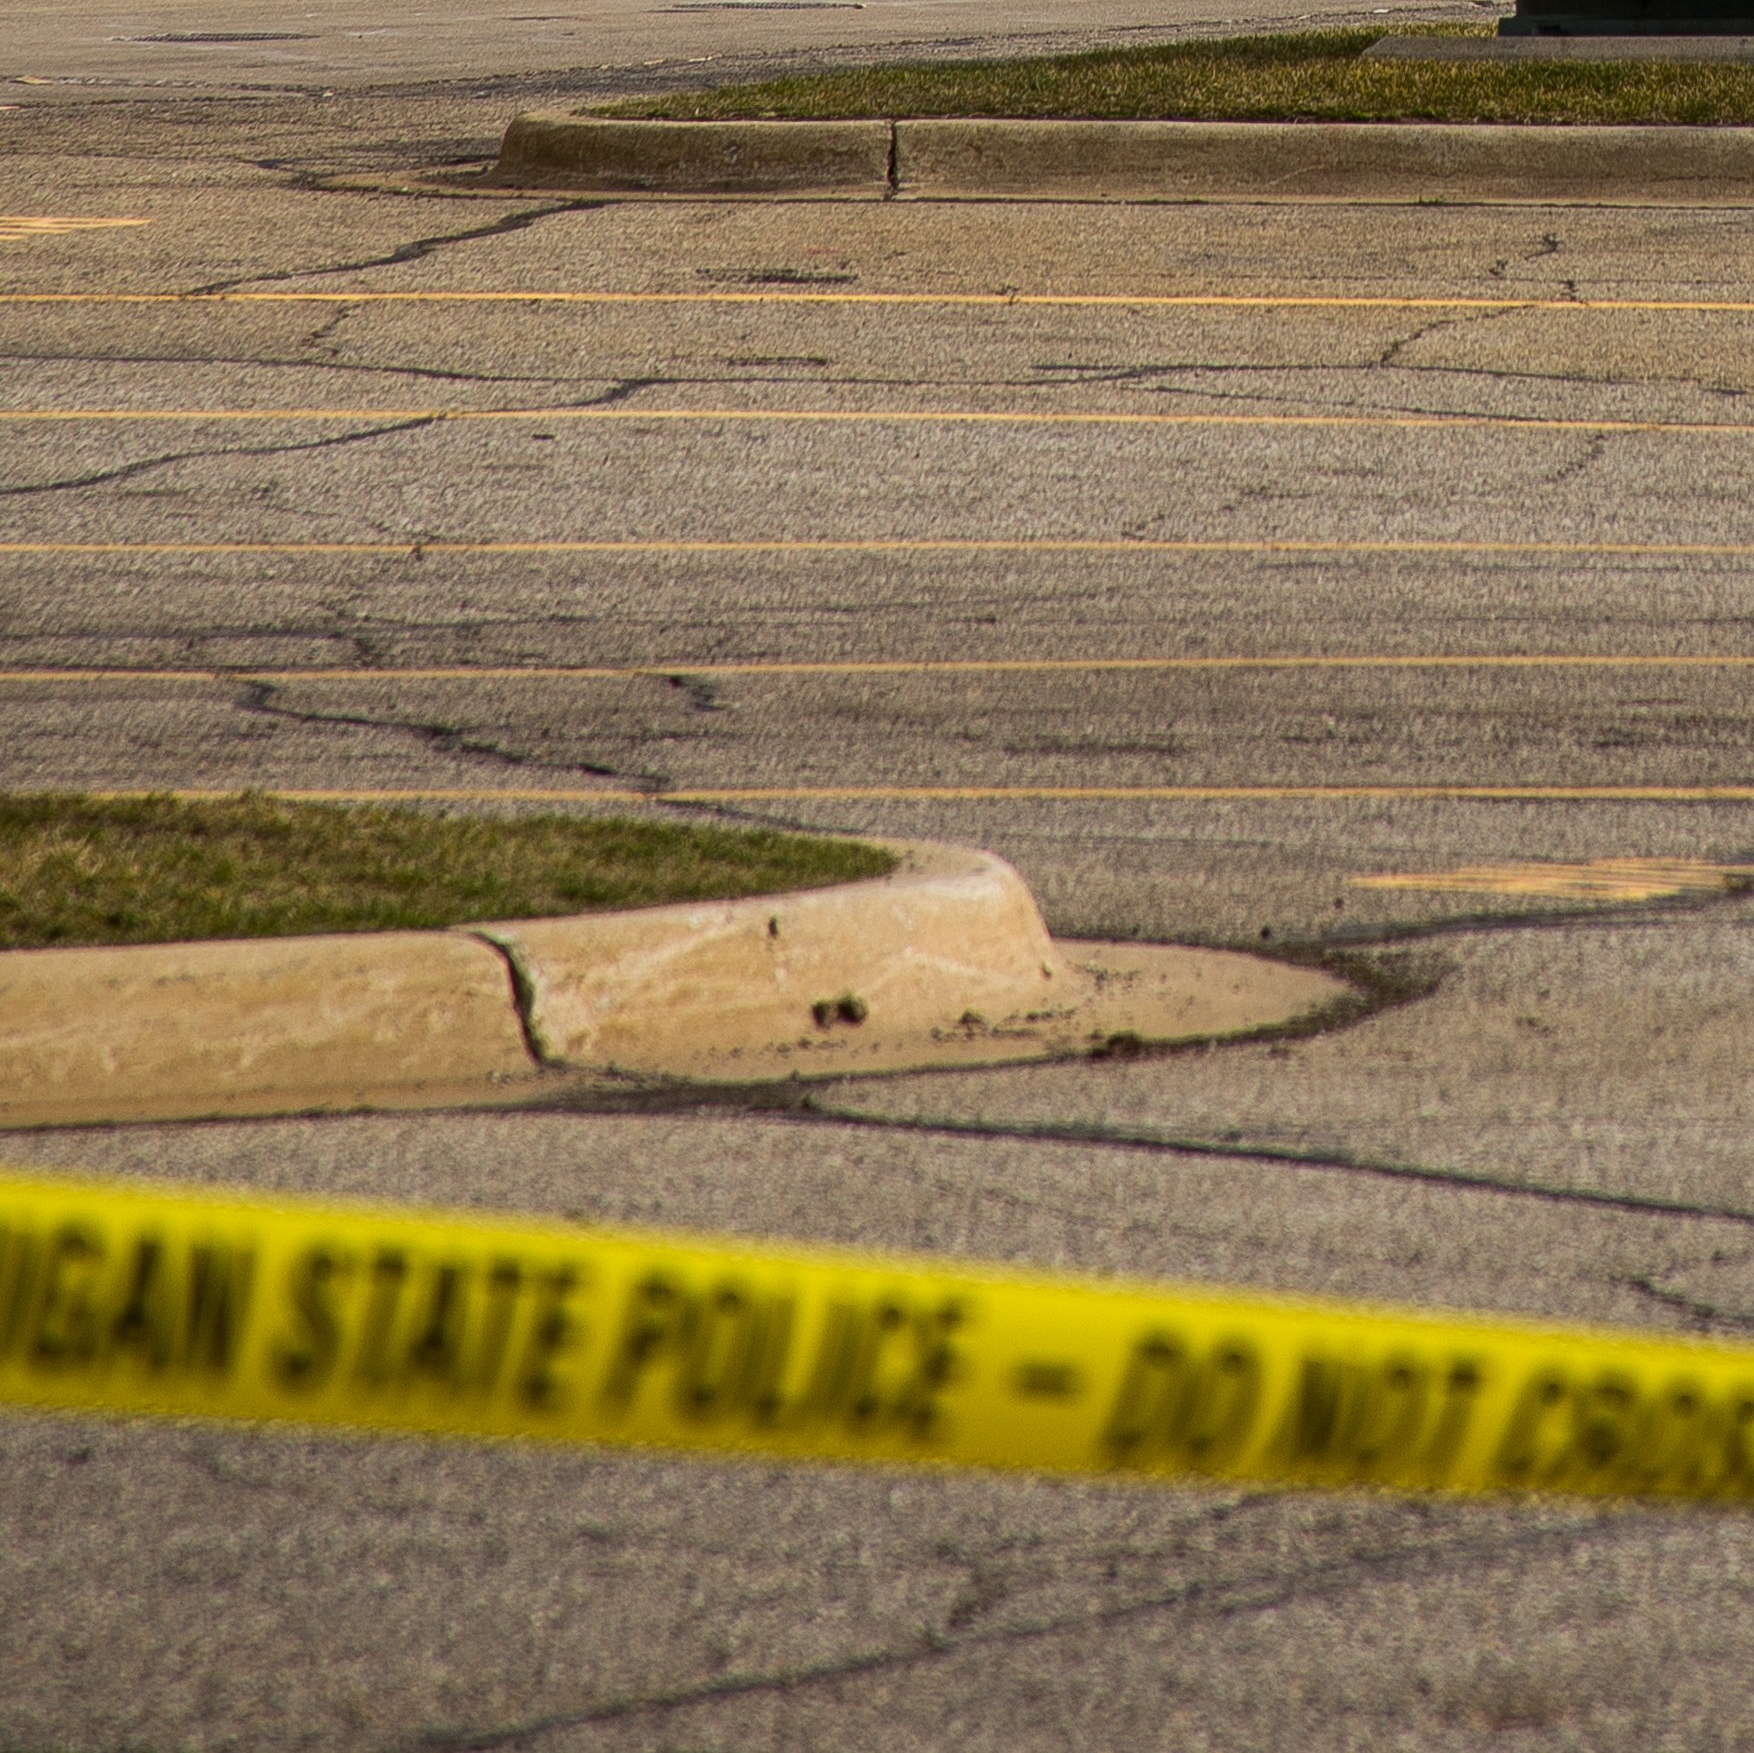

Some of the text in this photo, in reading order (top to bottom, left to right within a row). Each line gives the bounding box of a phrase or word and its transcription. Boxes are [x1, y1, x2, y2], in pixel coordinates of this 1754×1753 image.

[0, 1215, 260, 1375] IGAN
[265, 1238, 590, 1415] STATE
[603, 1265, 972, 1443] POLICE
[1096, 1327, 1264, 1467] DO
[1268, 1343, 1488, 1475] NOT
